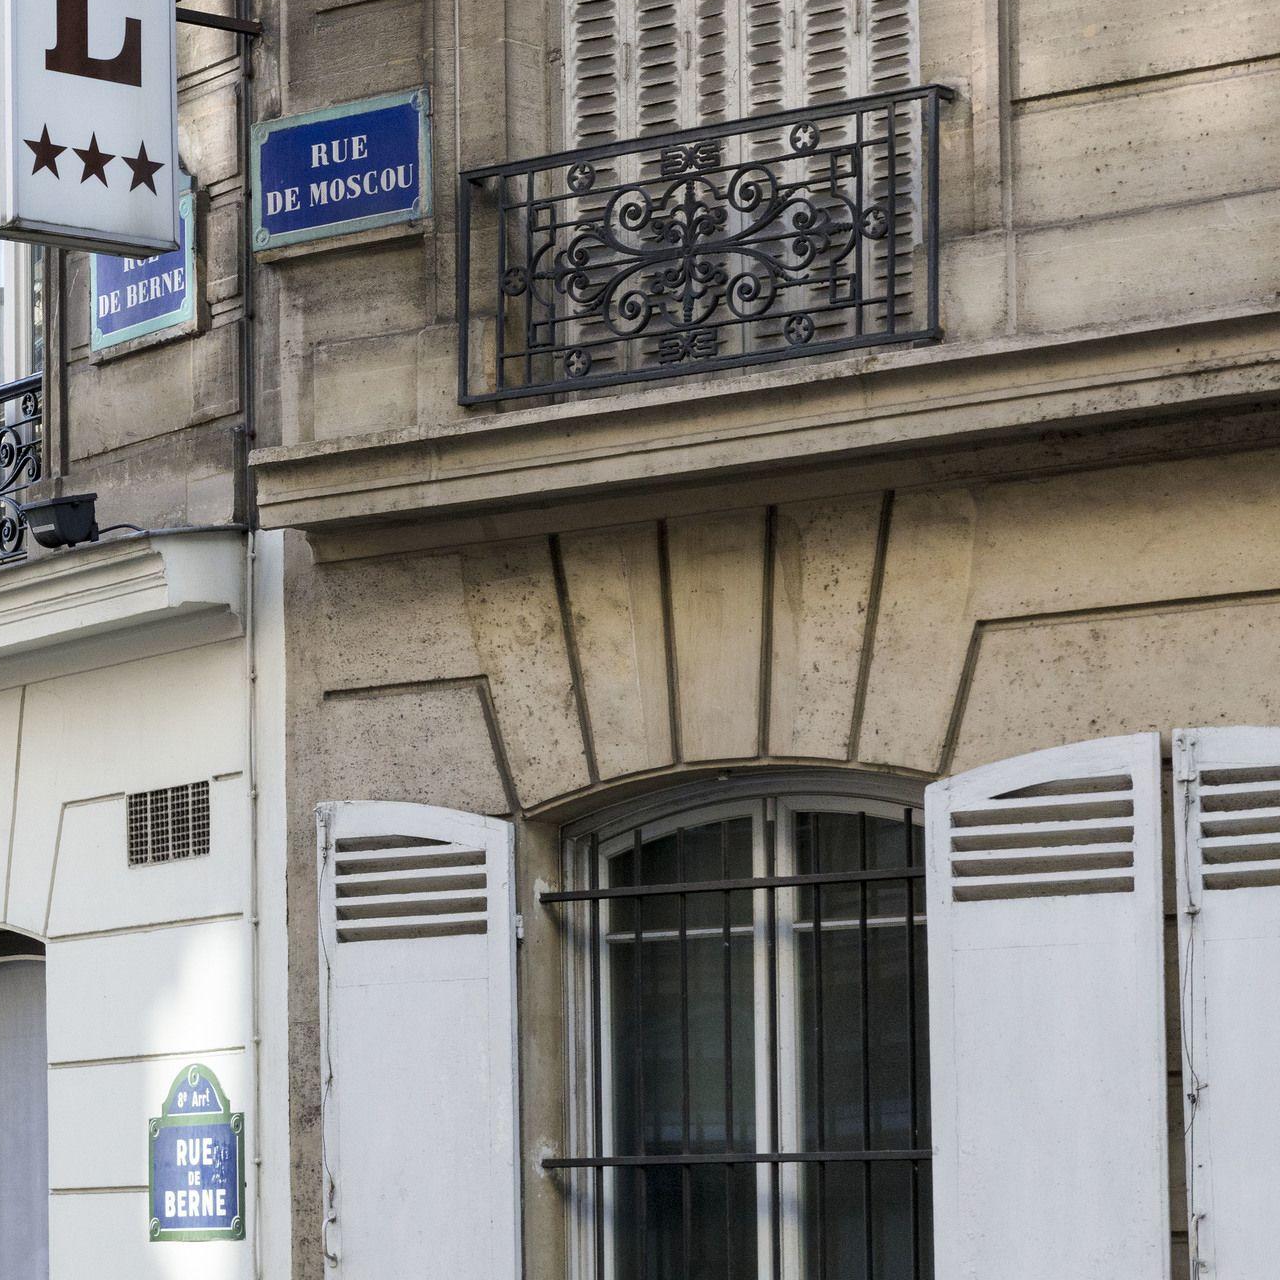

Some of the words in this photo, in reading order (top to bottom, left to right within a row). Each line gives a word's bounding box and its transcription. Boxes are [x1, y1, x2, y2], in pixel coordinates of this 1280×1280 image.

[311, 135, 368, 169] RUE
[266, 186, 301, 216] DE
[309, 163, 413, 208] MOSCOU
[98, 290, 121, 318] DE
[126, 267, 185, 308] BERNE
[176, 1137, 213, 1167] RUE
[187, 1170, 201, 1187] DE
[164, 1188, 227, 1218] BERNE
